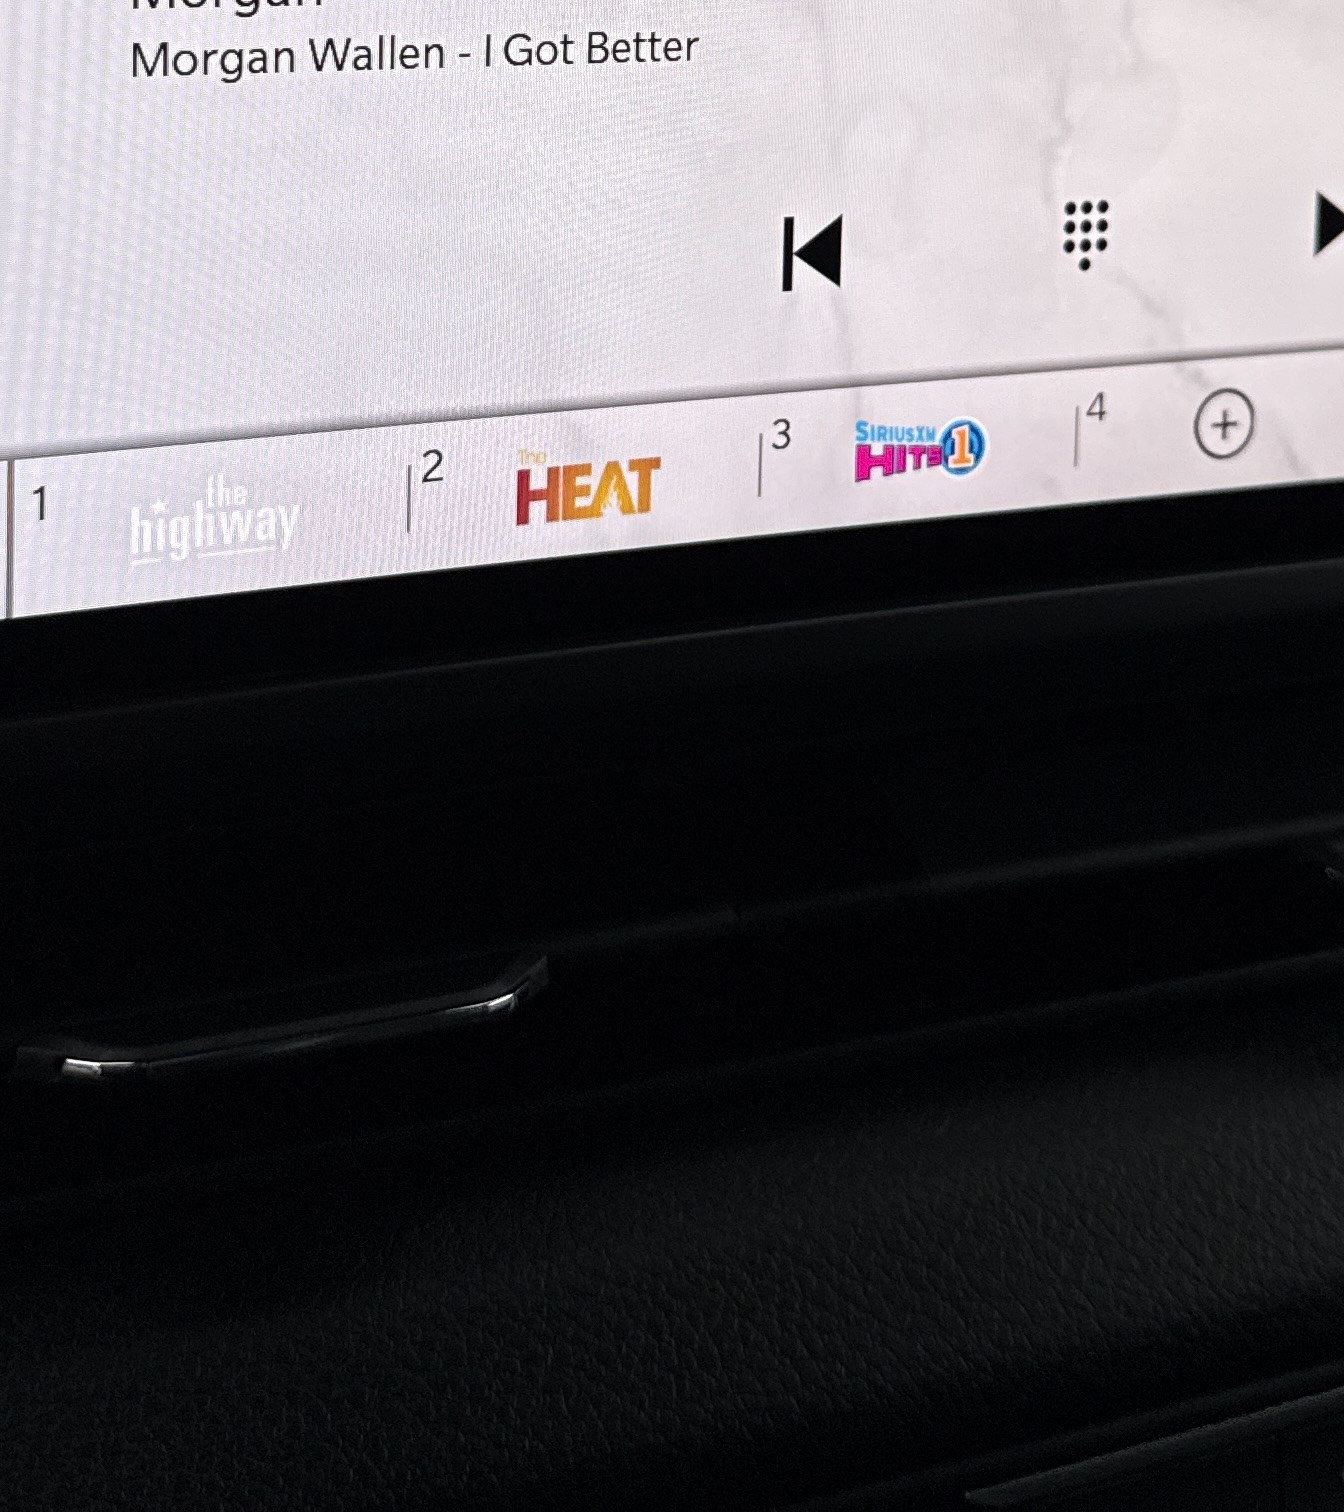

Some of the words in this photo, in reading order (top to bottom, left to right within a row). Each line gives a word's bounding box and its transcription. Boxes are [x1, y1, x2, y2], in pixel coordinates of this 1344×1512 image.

[134, 43, 295, 84] Morgan
[310, 36, 445, 72] Wallen
[505, 35, 574, 67] Got
[589, 33, 700, 64] Better
[1088, 394, 1107, 421] 4
[774, 420, 791, 450] 3
[423, 450, 444, 483] 2
[855, 444, 943, 482] HITS
[949, 425, 973, 467] 1
[35, 487, 45, 521] 1
[207, 473, 248, 507] the
[516, 457, 661, 526] HEAT
[130, 500, 301, 561] highway
